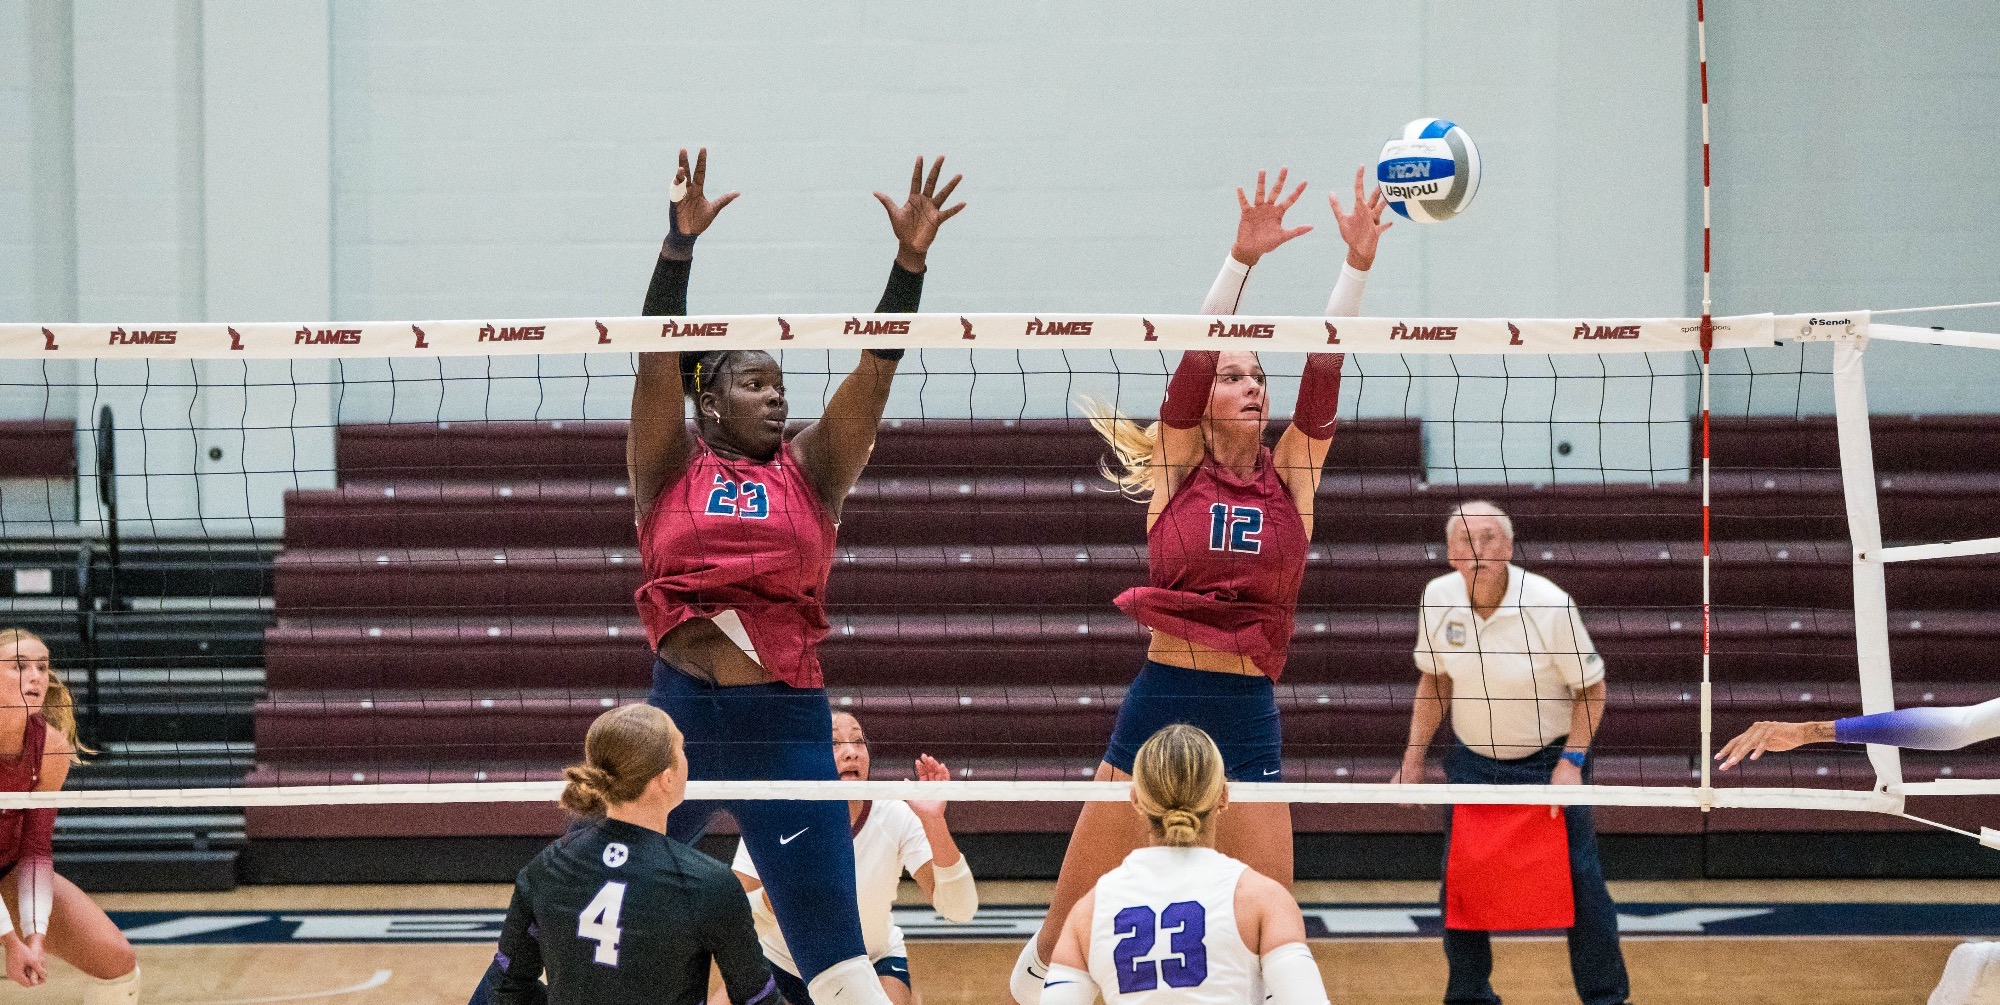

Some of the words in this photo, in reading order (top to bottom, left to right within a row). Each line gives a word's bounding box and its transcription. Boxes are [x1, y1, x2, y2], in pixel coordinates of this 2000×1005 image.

[1387, 161, 1431, 179] NCAA
[1386, 182, 1438, 199] molten
[662, 320, 729, 338] FLAMES
[844, 319, 912, 336] FLAMES
[1026, 318, 1094, 336] FLAMES
[1208, 319, 1276, 339] FLAMES
[1818, 318, 1851, 326] Senoh
[109, 327, 178, 345] FLAMES
[295, 327, 362, 345] FLAMES
[479, 325, 545, 342] FLAMES
[1390, 322, 1459, 341] FLAMES
[1573, 323, 1642, 340] FLAMES
[704, 473, 770, 519] 23
[1209, 502, 1264, 554] 12
[577, 880, 626, 969] 4
[1113, 900, 1208, 994] 23
